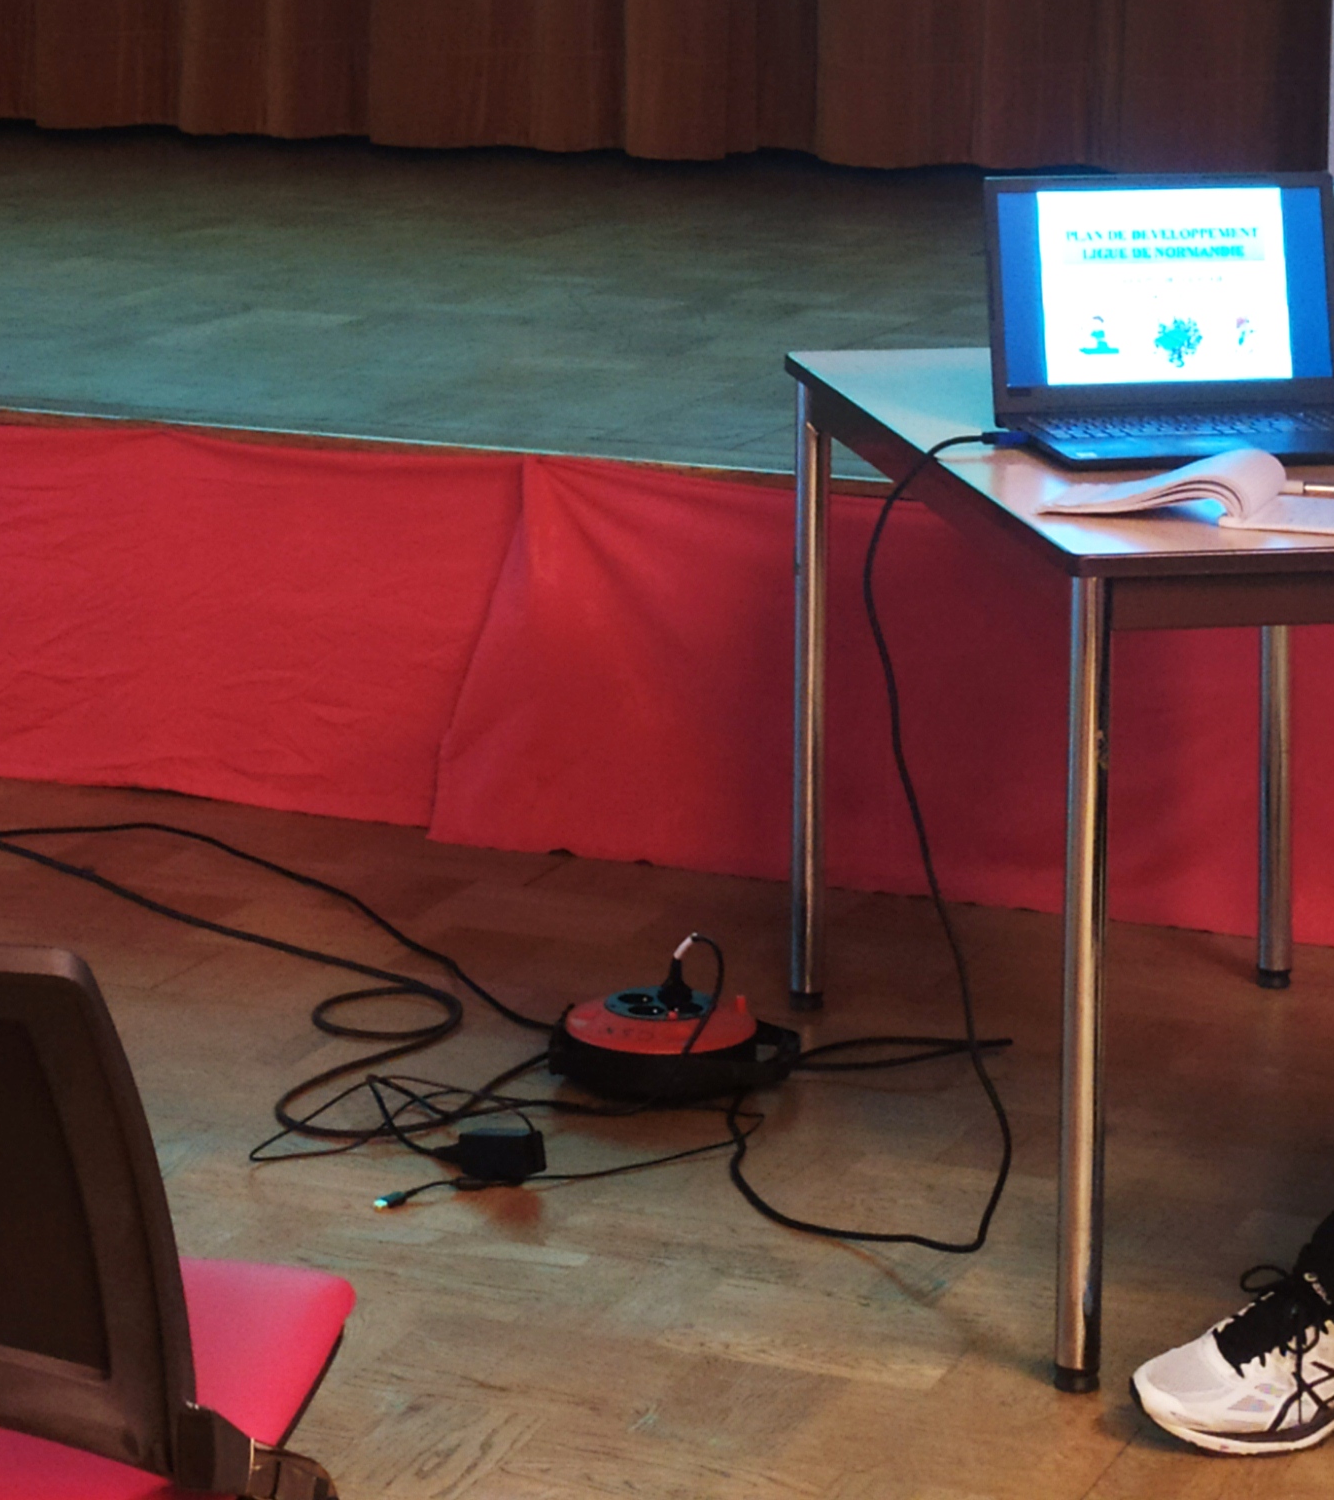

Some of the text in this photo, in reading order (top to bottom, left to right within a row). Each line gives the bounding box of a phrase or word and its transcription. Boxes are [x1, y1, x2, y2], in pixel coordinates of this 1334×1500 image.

[1065, 227, 1259, 243] PLAN DE DEVELOPPEMENT
[1082, 244, 1246, 260] LIGUE DE NORMANDIE
